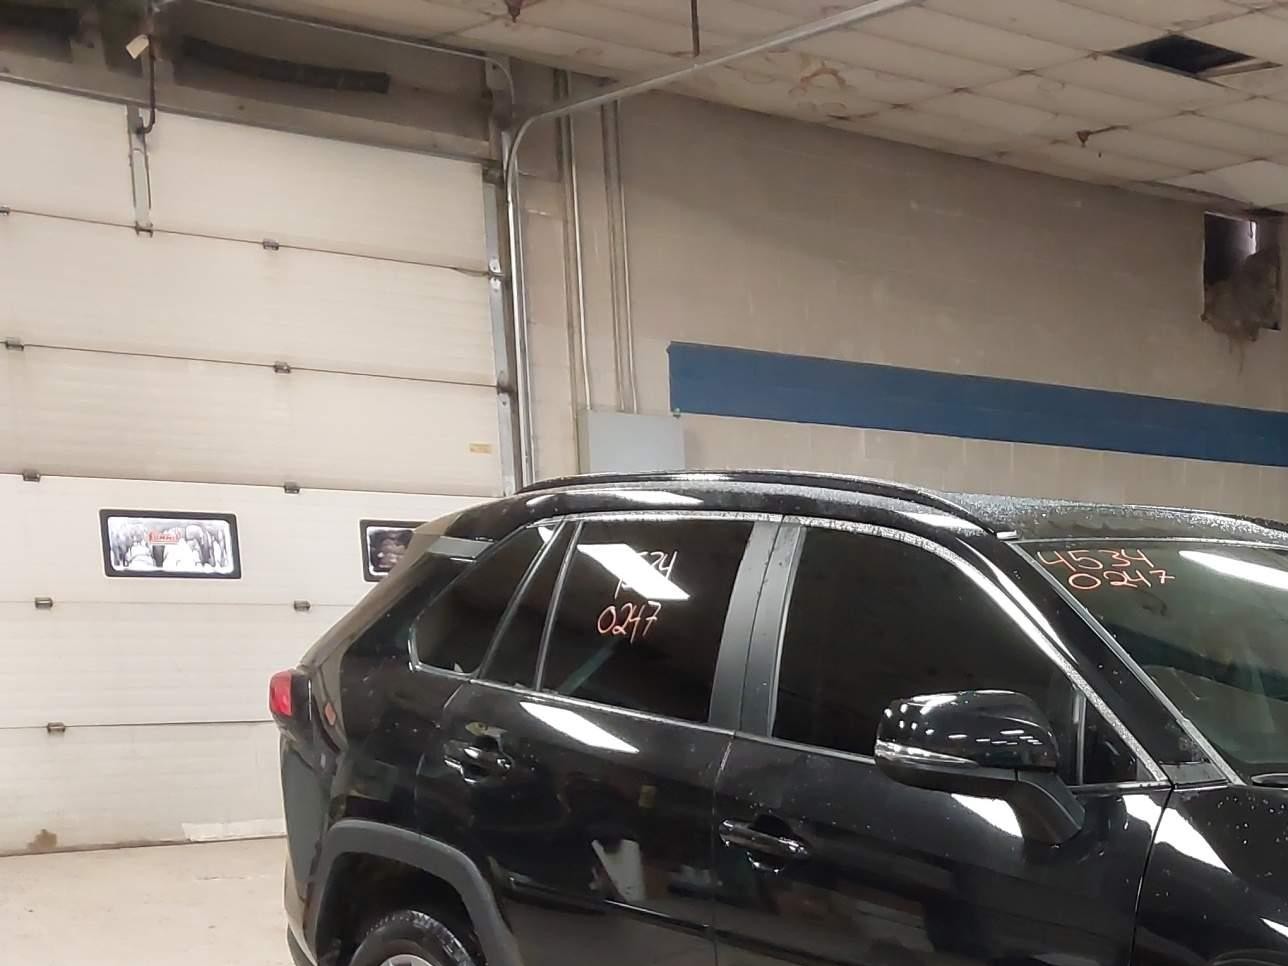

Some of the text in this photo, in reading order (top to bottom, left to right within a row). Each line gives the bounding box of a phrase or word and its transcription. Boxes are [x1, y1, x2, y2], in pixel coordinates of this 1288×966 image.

[1037, 549, 1154, 572] 4534
[1068, 570, 1175, 589] 0247
[597, 600, 661, 643] 0247
